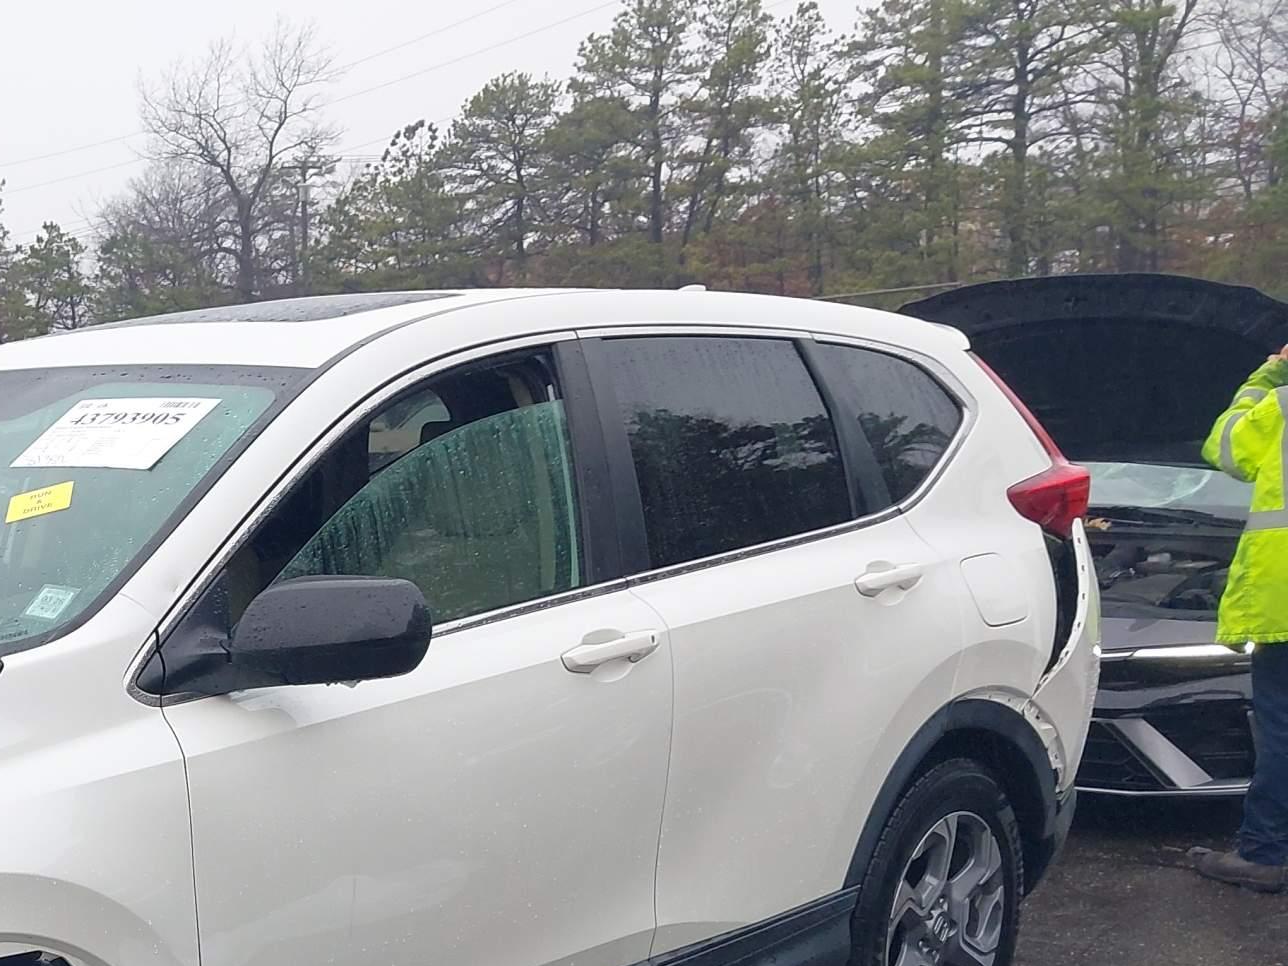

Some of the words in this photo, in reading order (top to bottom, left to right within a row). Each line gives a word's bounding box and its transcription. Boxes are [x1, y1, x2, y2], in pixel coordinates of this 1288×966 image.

[70, 411, 187, 426] 43793905
[29, 489, 53, 501] RUN
[22, 502, 53, 514] DRIVE
